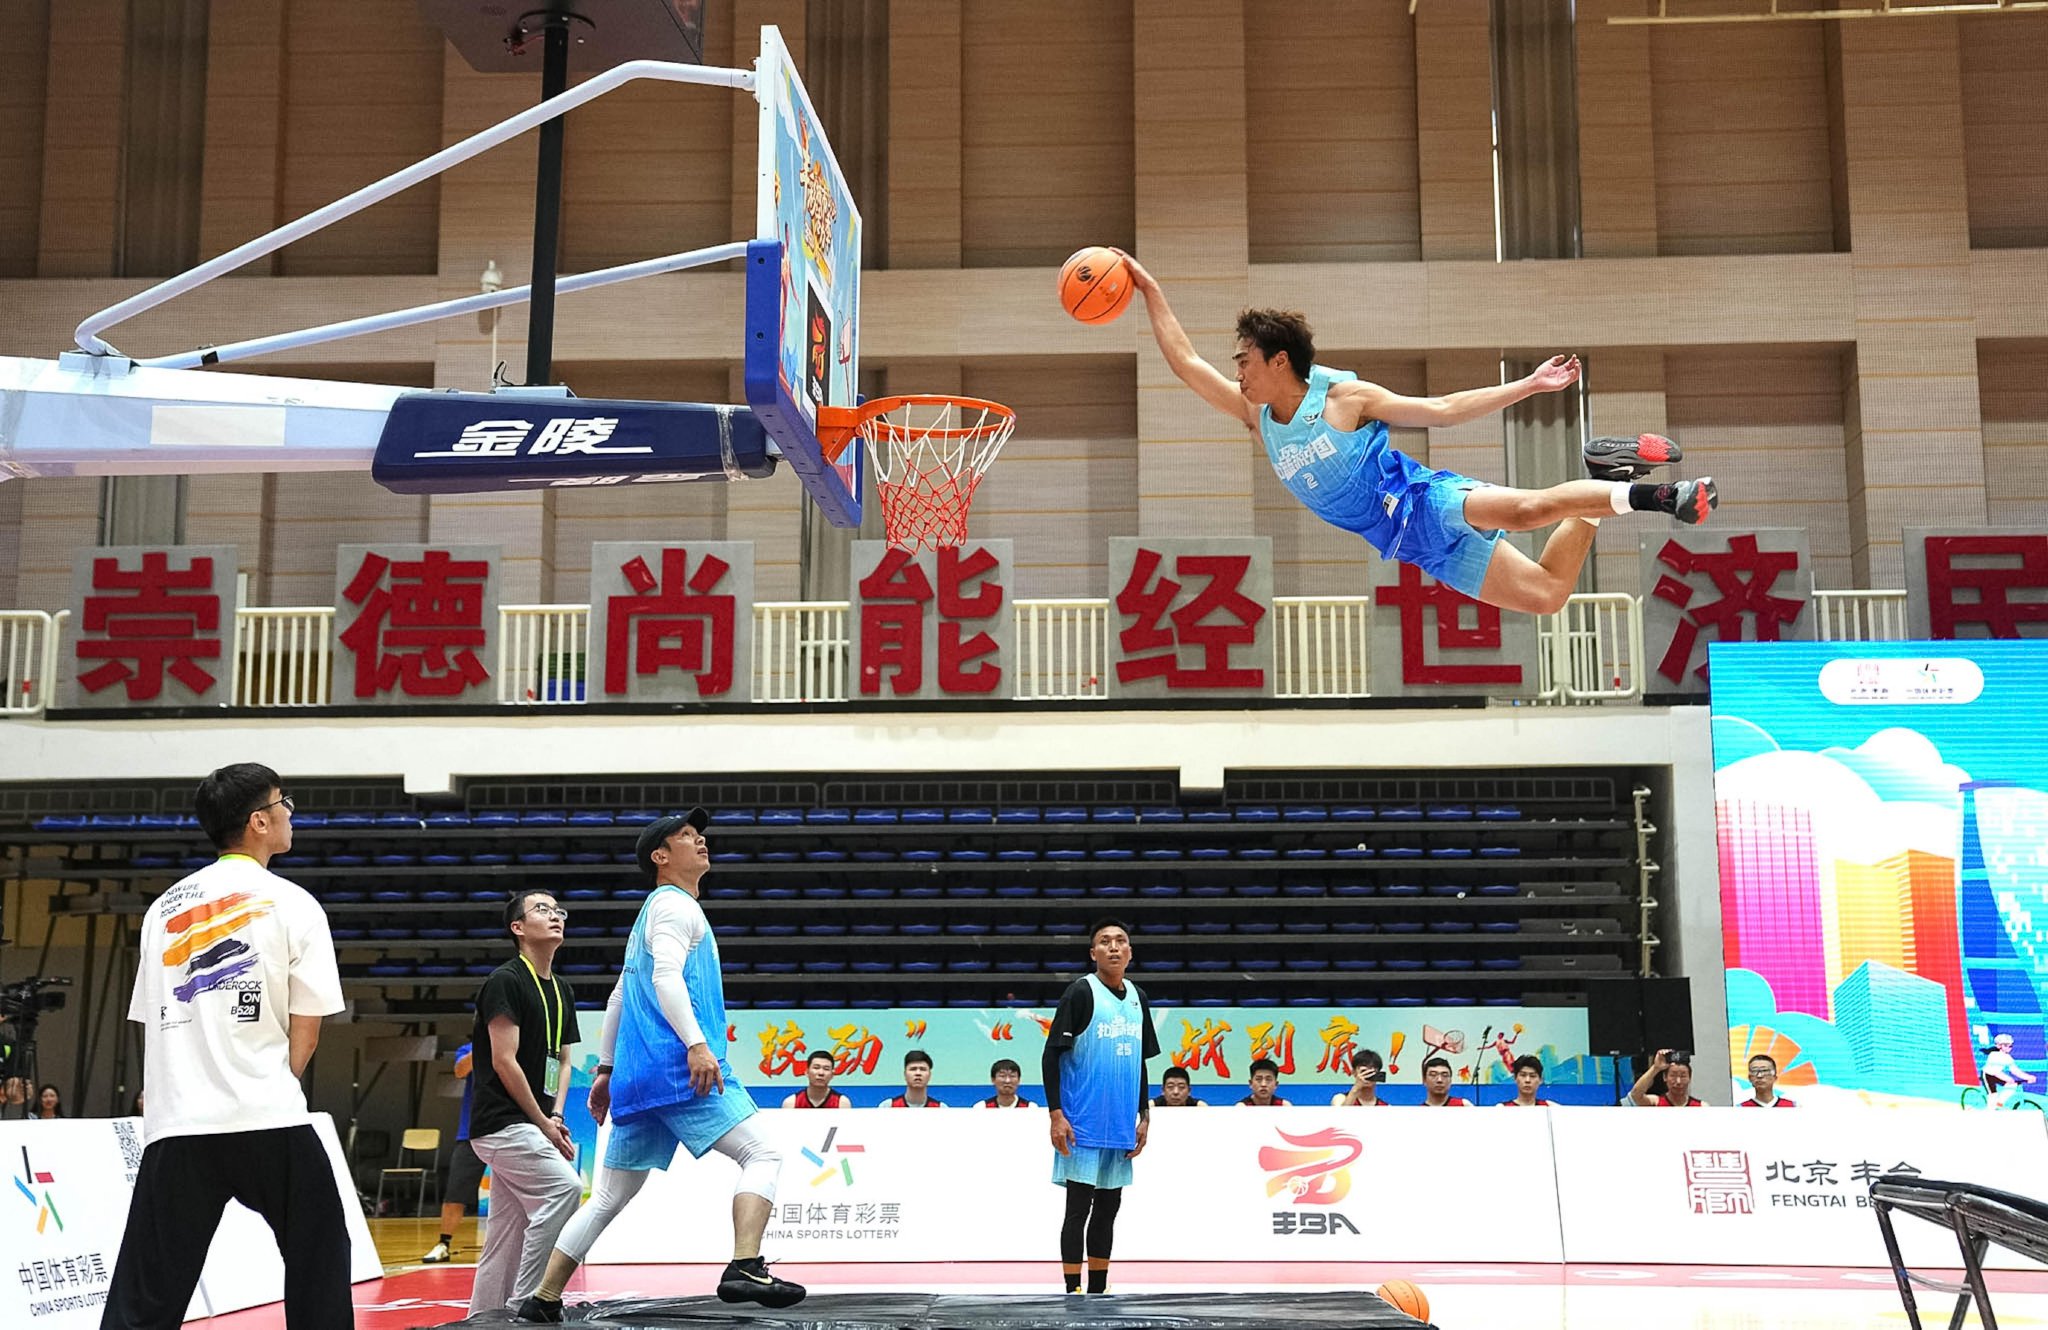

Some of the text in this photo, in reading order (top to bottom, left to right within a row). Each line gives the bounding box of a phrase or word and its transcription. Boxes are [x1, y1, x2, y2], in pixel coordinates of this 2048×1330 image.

[414, 417, 653, 458] 金陵
[242, 992, 261, 1003] ON
[1117, 1043, 1132, 1056] 25
[1766, 1161, 1838, 1186] 北京
[1771, 1194, 1846, 1208] FENGTAI
[797, 1229, 843, 1240] SPORTS
[847, 1229, 899, 1240] LOTTERY
[18, 1252, 109, 1295] 中国体育彩票
[30, 1290, 108, 1316] CHINA SPORTS LOTTE
